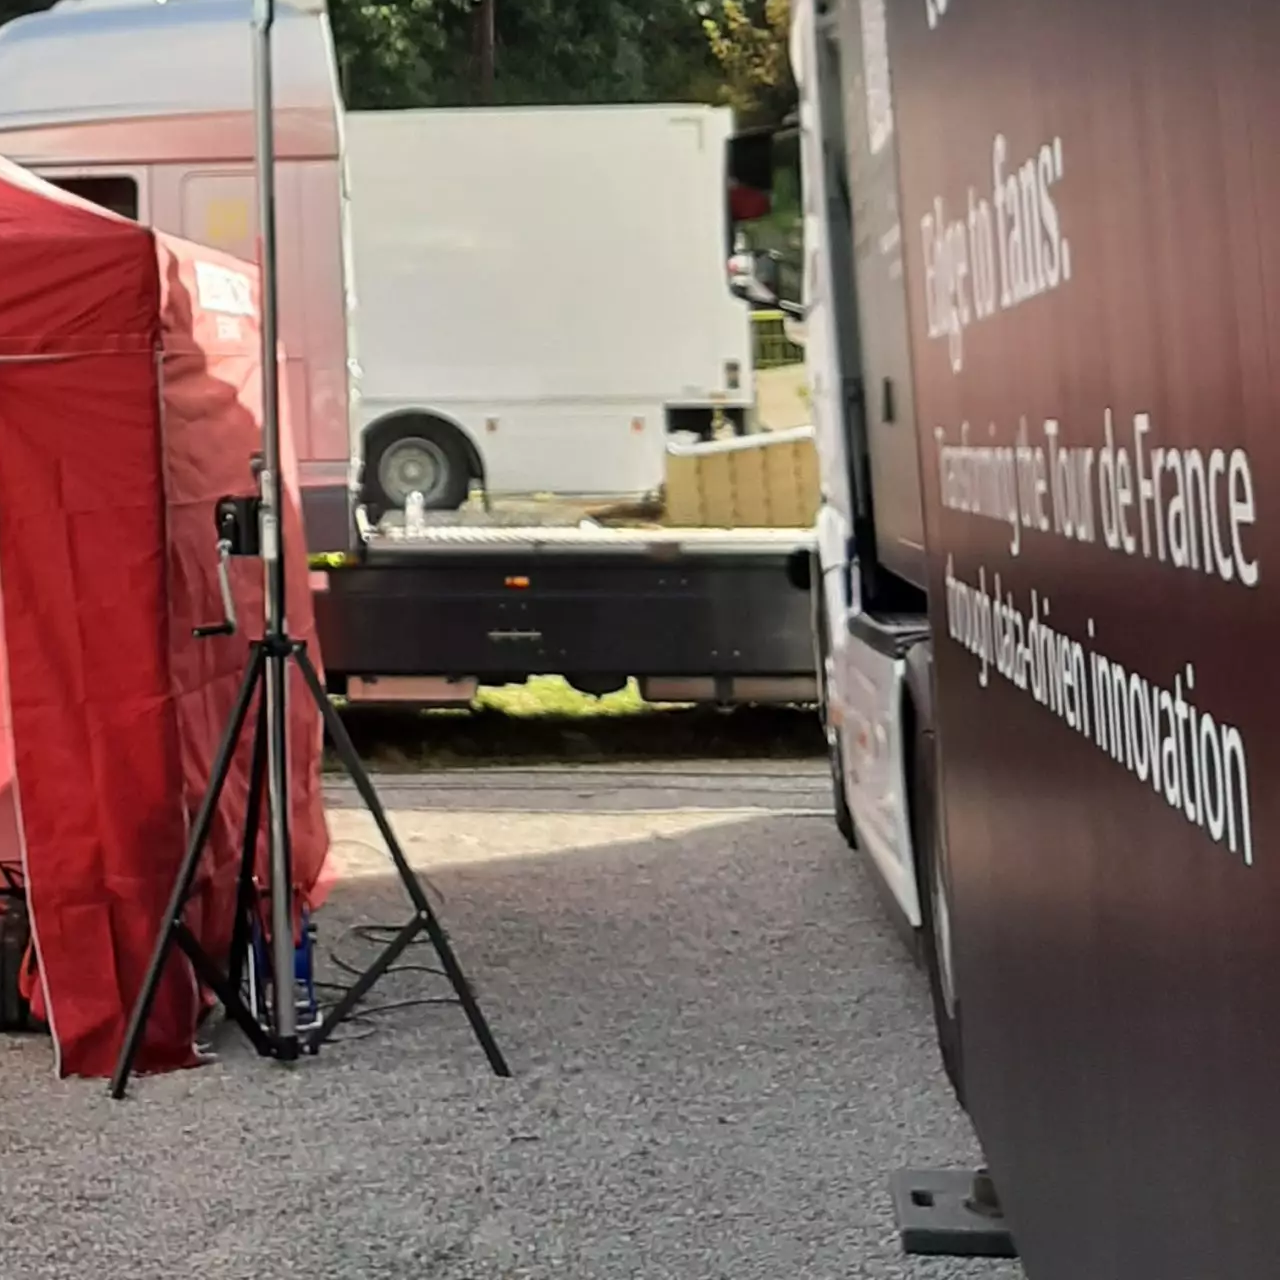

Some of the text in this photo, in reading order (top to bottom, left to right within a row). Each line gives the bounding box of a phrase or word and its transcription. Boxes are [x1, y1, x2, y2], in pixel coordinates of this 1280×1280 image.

[968, 186, 995, 319] to
[1043, 419, 1095, 542] Tour
[1098, 407, 1136, 555] de
[1133, 413, 1260, 587] France
[945, 552, 1254, 867] through data-driven innovation
